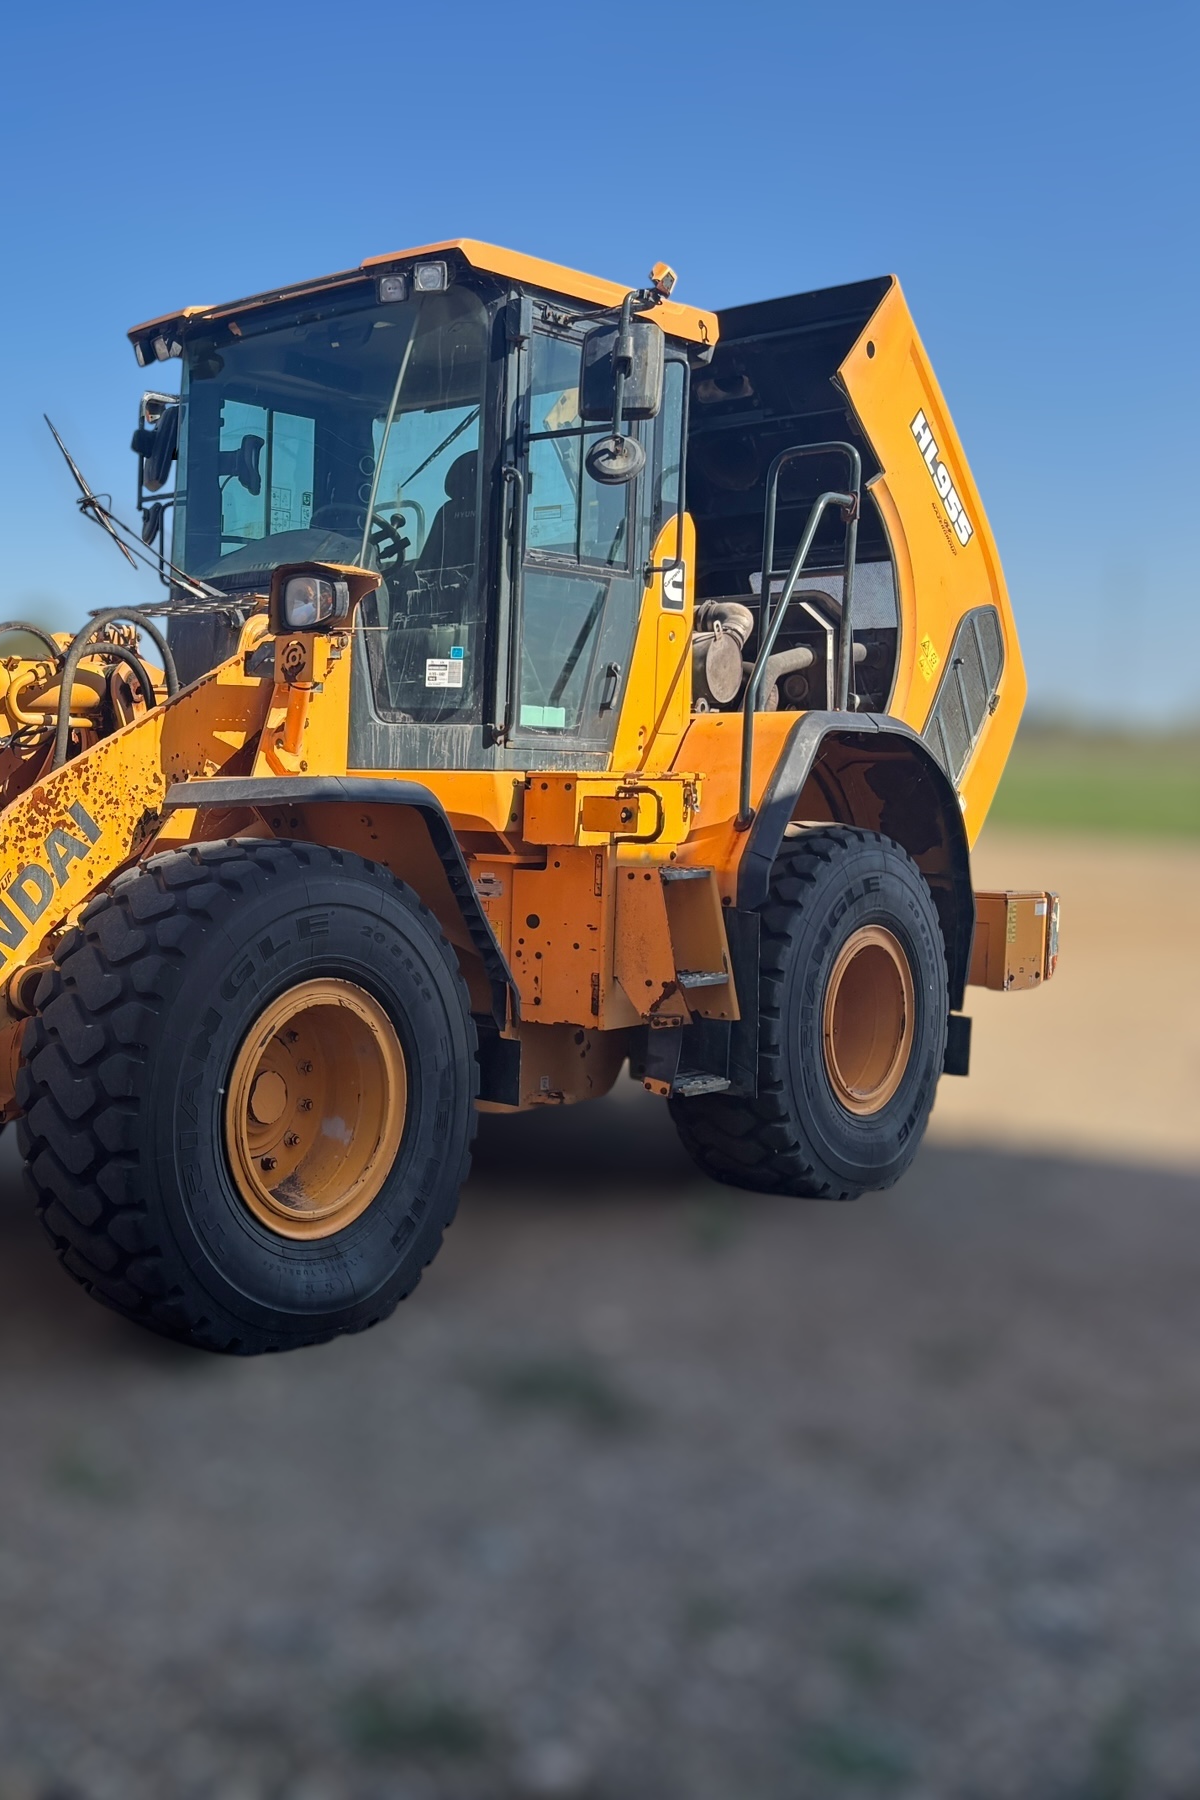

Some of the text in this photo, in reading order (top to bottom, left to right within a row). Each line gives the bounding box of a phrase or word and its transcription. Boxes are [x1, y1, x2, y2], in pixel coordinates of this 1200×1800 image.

[453, 510, 476, 519] HYUN
[909, 407, 974, 548] HL955
[179, 911, 330, 1263] TRIANGLE
